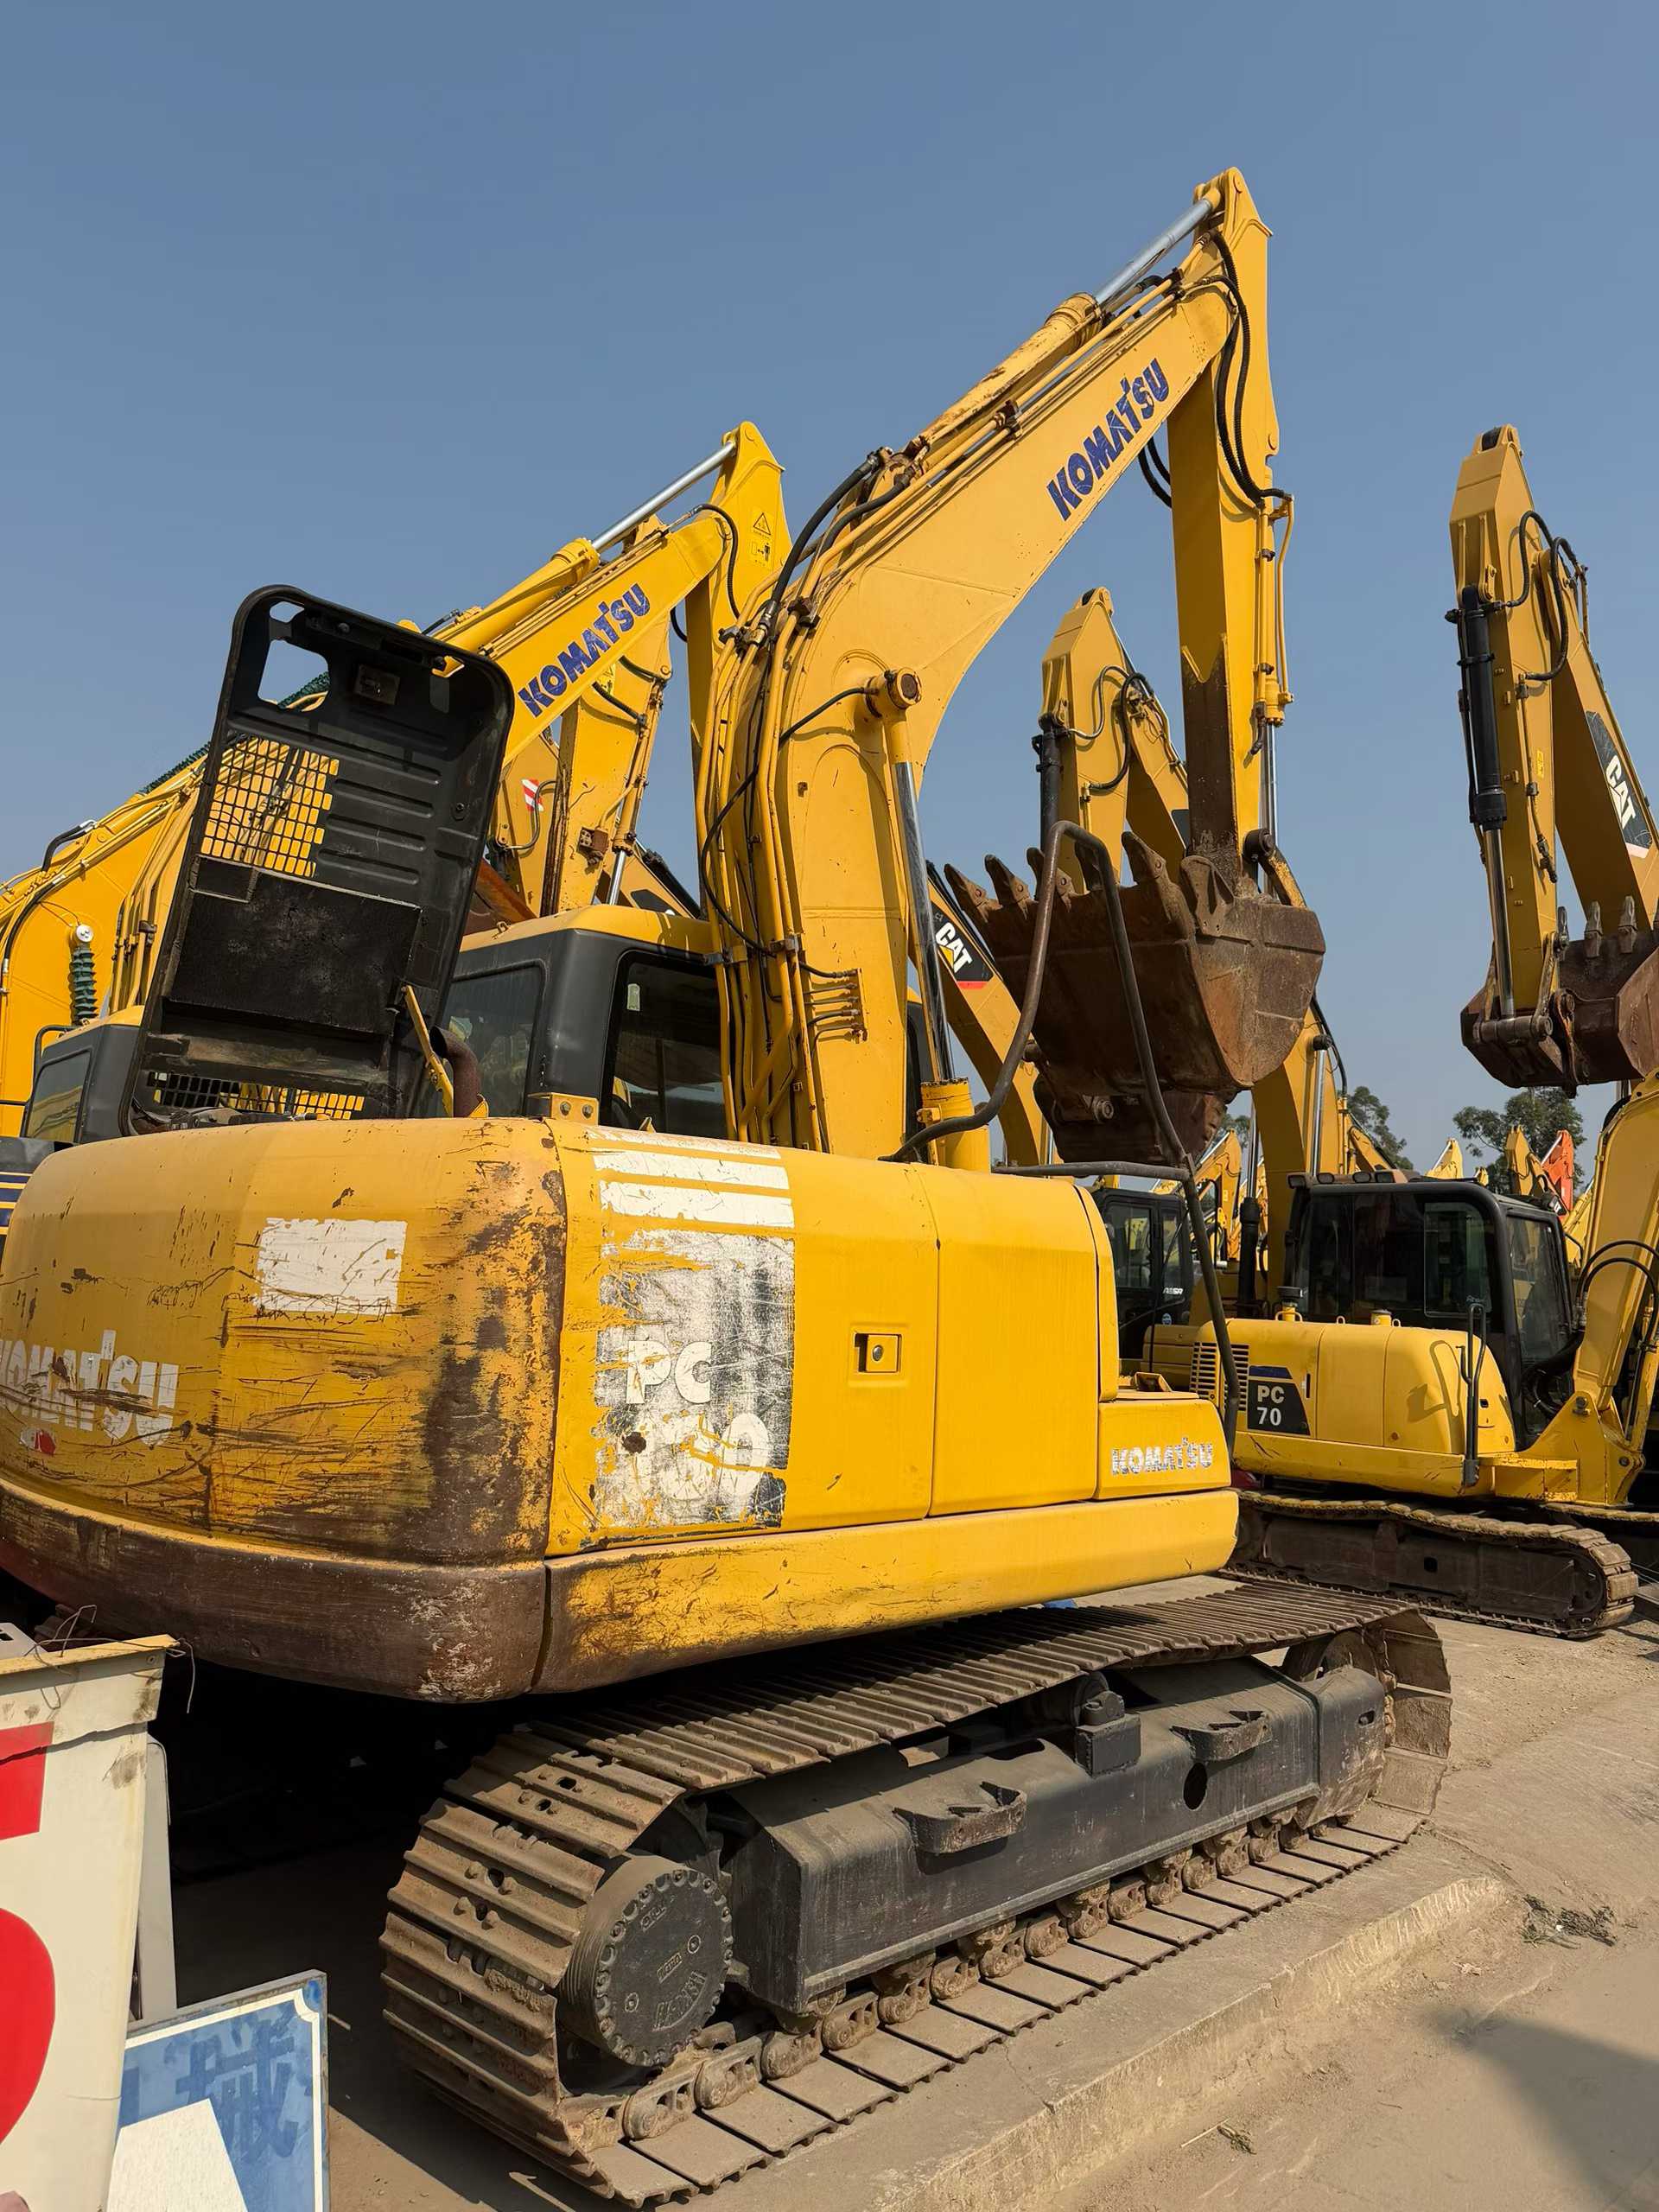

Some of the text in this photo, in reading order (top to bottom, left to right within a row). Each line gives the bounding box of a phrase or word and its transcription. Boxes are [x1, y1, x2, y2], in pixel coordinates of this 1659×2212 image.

[1046, 358, 1169, 521] KOMATSU
[518, 582, 651, 717] KOMATSU
[1605, 754, 1636, 830] CAT
[935, 922, 973, 973] CAT
[626, 1341, 712, 1404] PC
[1257, 1385, 1285, 1403] PC
[1256, 1407, 1281, 1426] 70
[1111, 1437, 1212, 1474] KOMATSU
